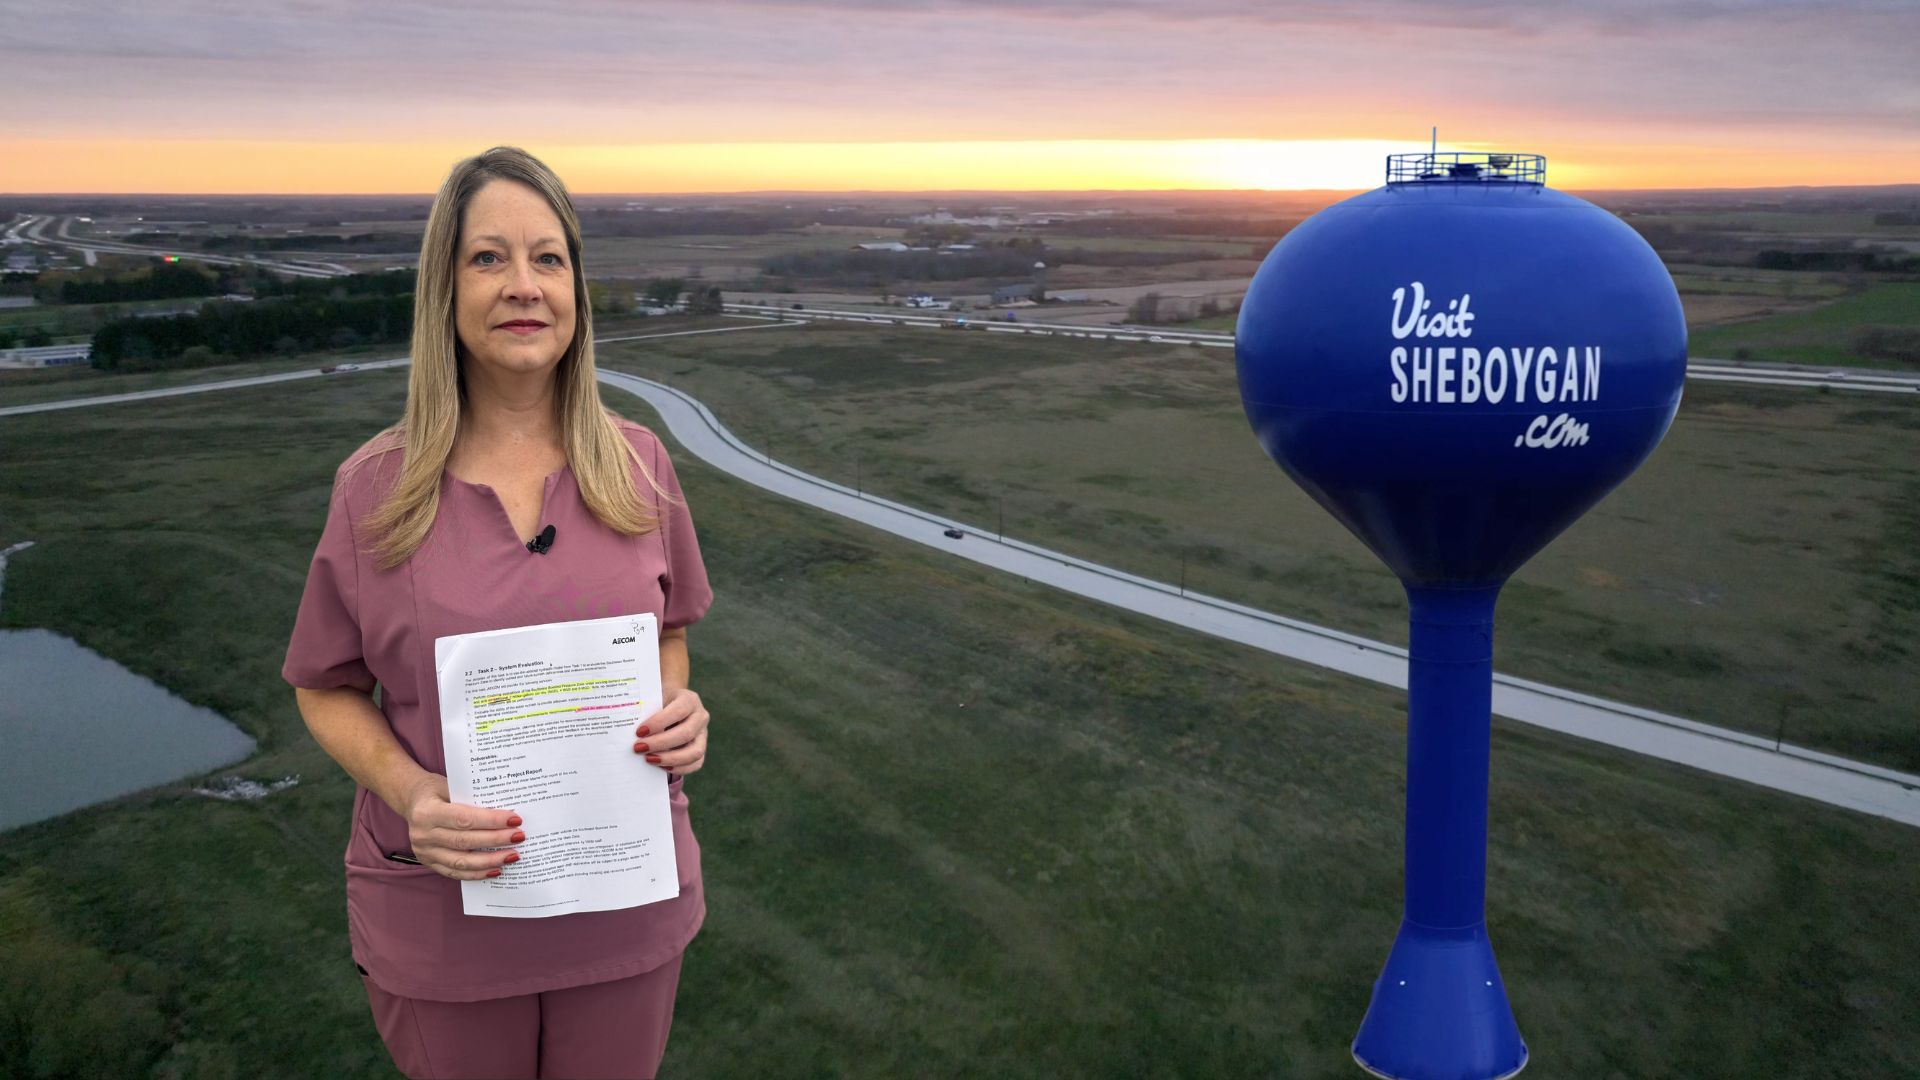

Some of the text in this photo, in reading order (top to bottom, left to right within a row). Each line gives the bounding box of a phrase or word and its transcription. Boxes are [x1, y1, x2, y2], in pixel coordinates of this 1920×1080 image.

[1391, 281, 1475, 339] Visit
[1390, 346, 1601, 404] SHEBOYGAN
[1514, 413, 1590, 449] .com
[612, 636, 635, 644] AECOM
[517, 660, 543, 668] Evaluation
